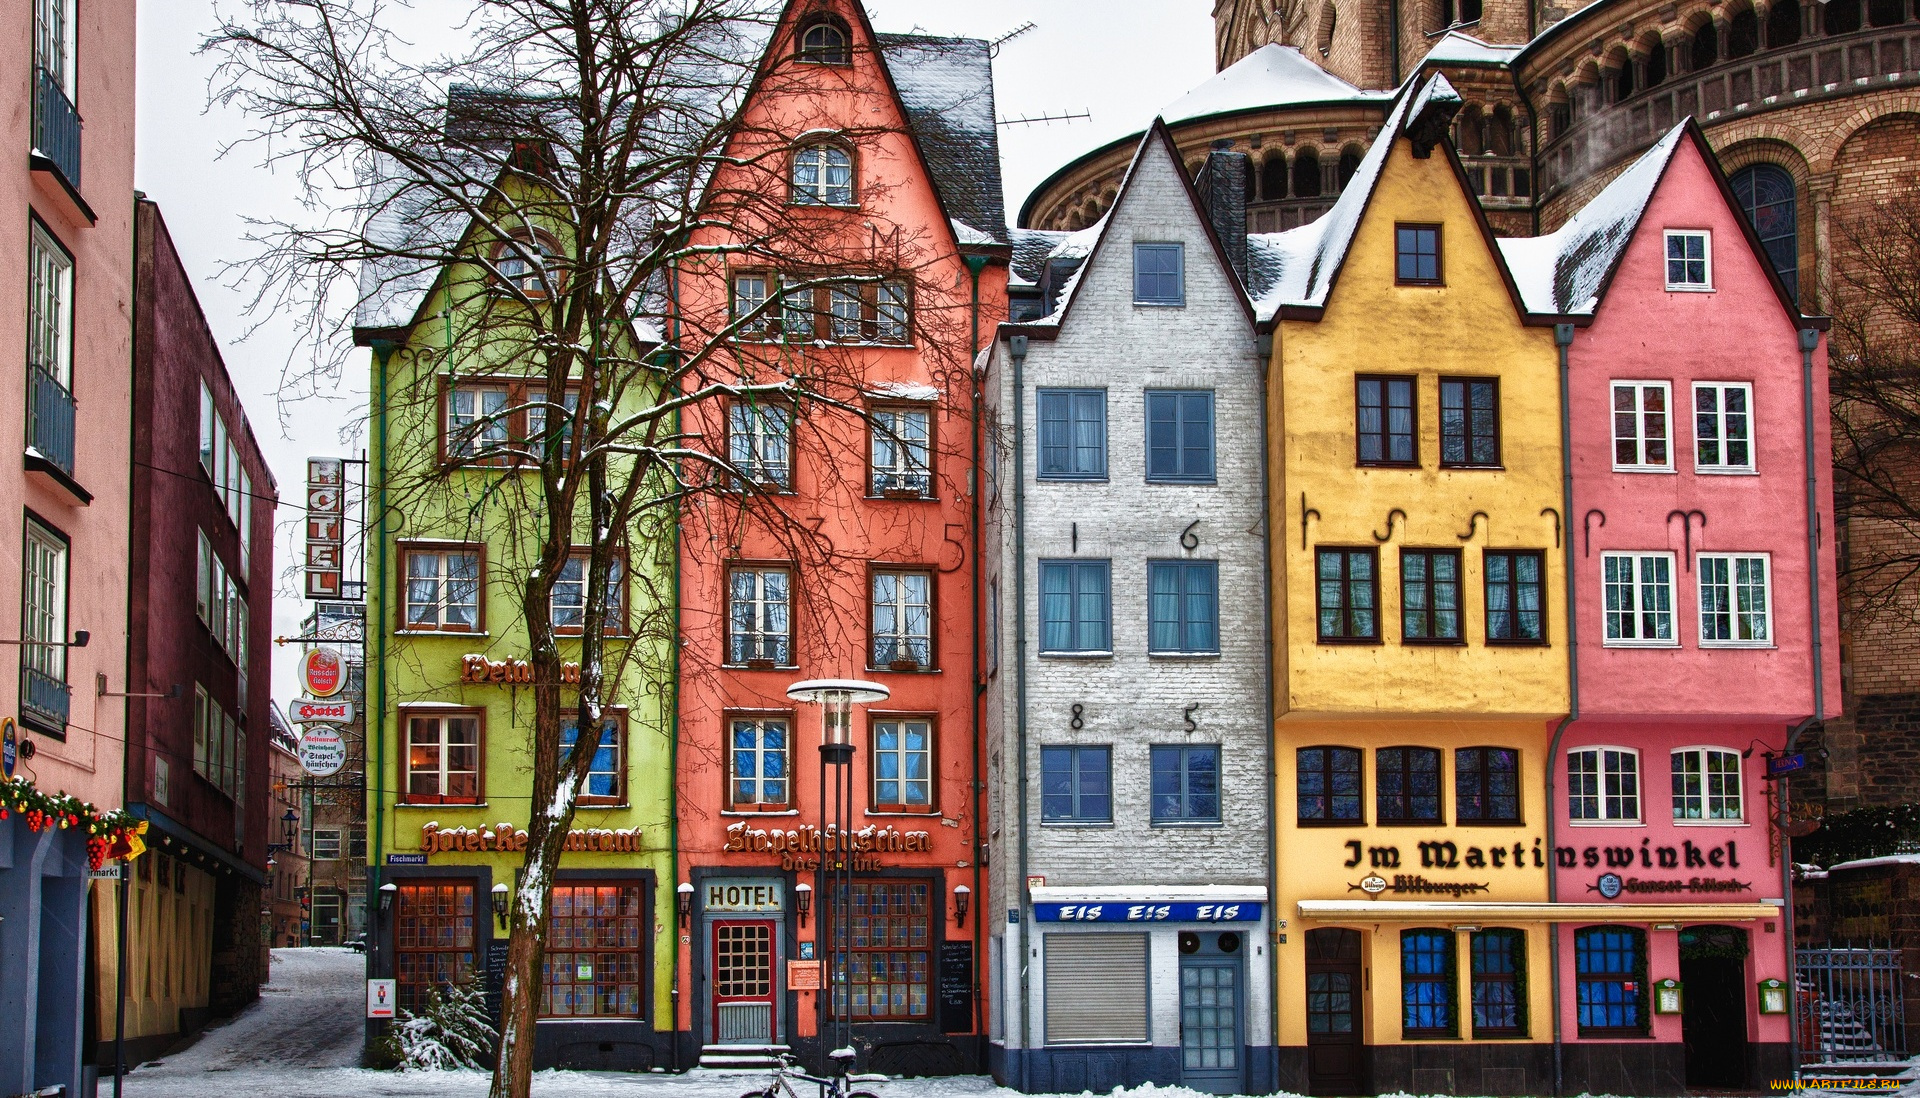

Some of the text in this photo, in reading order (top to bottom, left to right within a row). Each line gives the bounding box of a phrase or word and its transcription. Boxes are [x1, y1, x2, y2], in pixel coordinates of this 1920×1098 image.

[310, 461, 337, 593] HOTEL
[299, 704, 346, 718] Hotel
[308, 752, 336, 761] Stapel-
[390, 854, 424, 863] Fischmarkt
[1343, 838, 1740, 869] Im Martinswinkel
[1393, 875, 1478, 897] Bitburger
[710, 886, 779, 906] HOTEL
[1059, 905, 1240, 920] EIS EIS EIS
[1374, 924, 1380, 933] 7
